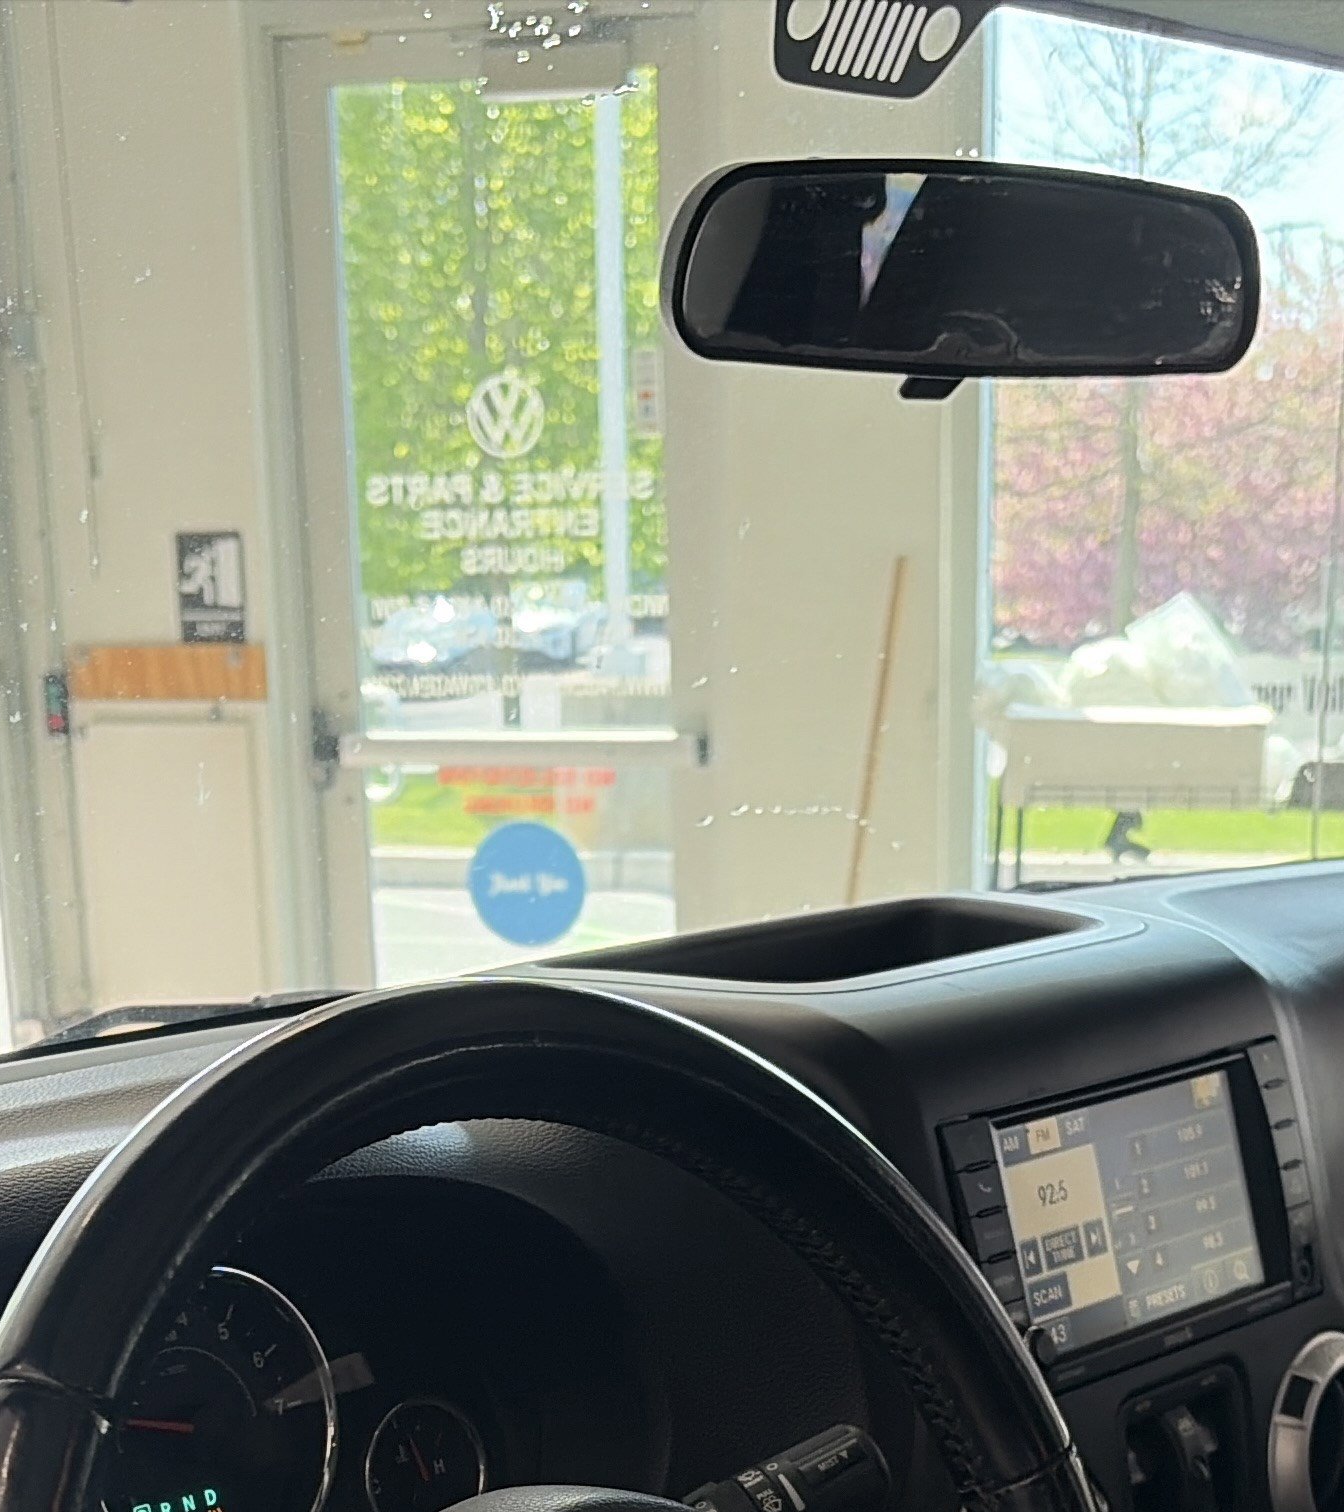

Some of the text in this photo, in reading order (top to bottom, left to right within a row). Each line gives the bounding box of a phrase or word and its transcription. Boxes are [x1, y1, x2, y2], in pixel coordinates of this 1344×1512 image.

[1035, 1127, 1051, 1143] FM
[1065, 1117, 1087, 1136] SAT
[1037, 1179, 1069, 1207] 92.5
[1033, 1284, 1063, 1307] SCAN
[217, 1322, 230, 1340] 5
[252, 1351, 265, 1369] 6
[433, 1458, 447, 1475] H
[182, 1494, 197, 1512] N
[204, 1488, 218, 1507] D
